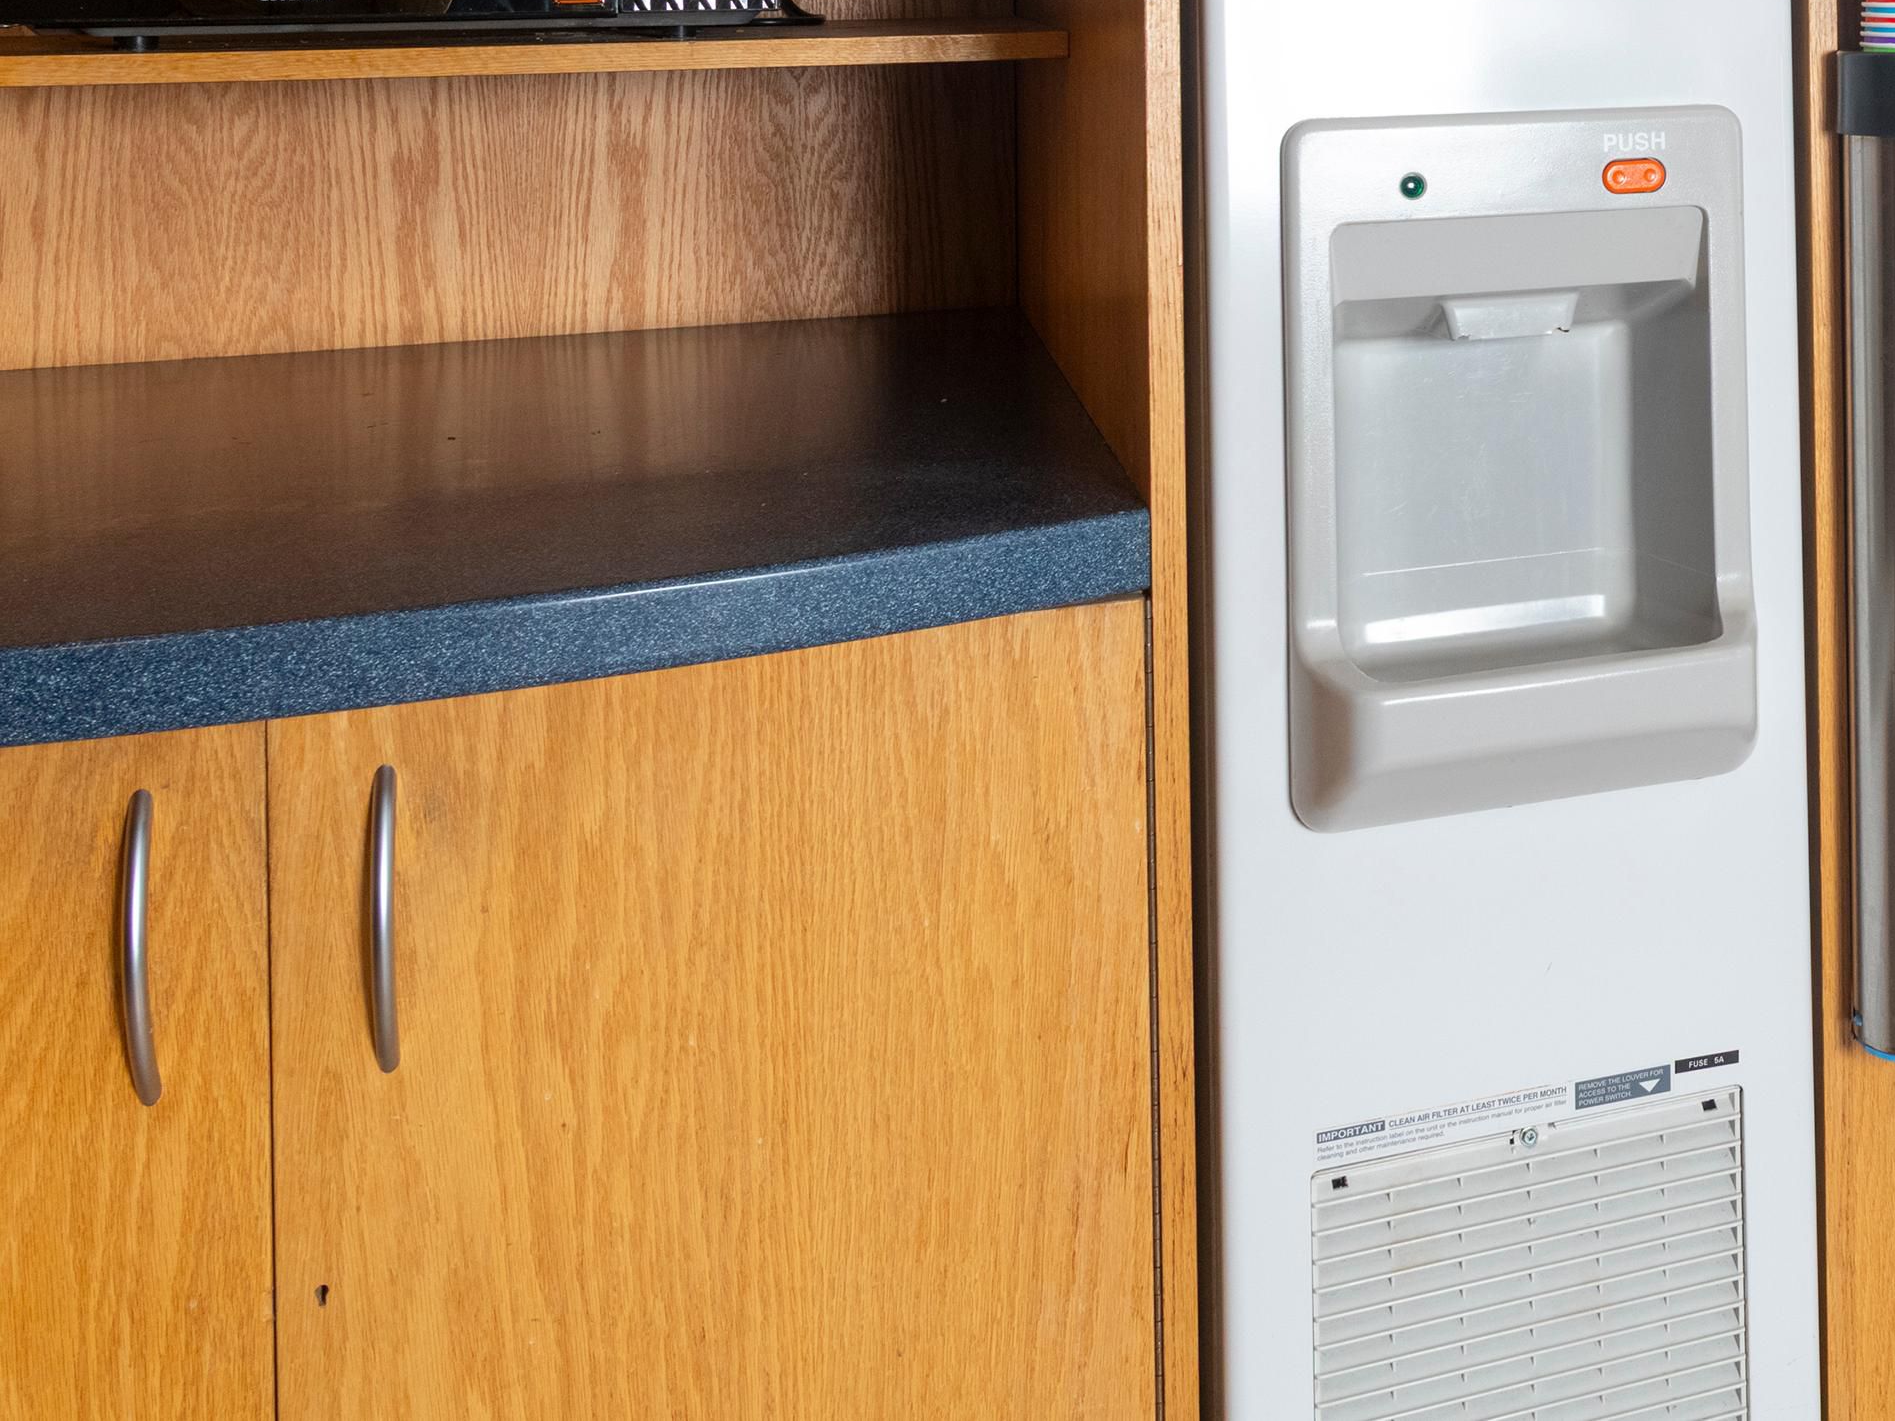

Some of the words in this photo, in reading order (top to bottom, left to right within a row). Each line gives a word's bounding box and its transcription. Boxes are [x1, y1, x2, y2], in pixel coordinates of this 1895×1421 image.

[1603, 131, 1666, 153] PUSH
[1688, 1058, 1708, 1069] FUSE
[1714, 1056, 1725, 1064] 5A
[1578, 1080, 1607, 1091] REMOVE
[1608, 1077, 1621, 1085] THE
[1622, 1072, 1648, 1083] LOUVER
[1650, 1068, 1664, 1077] FOR
[1578, 1089, 1606, 1099] ACCESS
[1618, 1083, 1631, 1091] THE
[1578, 1097, 1604, 1107] POWER
[1318, 1121, 1384, 1143] IMPORTANT
[1389, 1116, 1416, 1128] CLEAN
[1417, 1113, 1430, 1122] AIR
[1432, 1107, 1458, 1119] FILTER
[1460, 1104, 1470, 1114] AT
[1472, 1100, 1496, 1111] LEAST
[1497, 1094, 1521, 1106] TWICE
[1523, 1092, 1538, 1102] PER
[1540, 1086, 1567, 1097] MONTH
[1317, 1145, 1335, 1154] Refer
[1344, 1140, 1354, 1148] the
[1356, 1134, 1387, 1145] instruction
[1389, 1131, 1404, 1139] label
[1415, 1126, 1425, 1134] the
[1427, 1124, 1438, 1132] unit
[1459, 1114, 1490, 1125] instruction
[1491, 1108, 1513, 1118] manual
[1515, 1106, 1523, 1114] for
[1524, 1103, 1543, 1114] proper
[1317, 1150, 1344, 1162] cleaning
[1346, 1147, 1358, 1156] and
[1360, 1144, 1376, 1153] other
[1377, 1136, 1416, 1149] maintenance
[1418, 1131, 1445, 1142] required.
